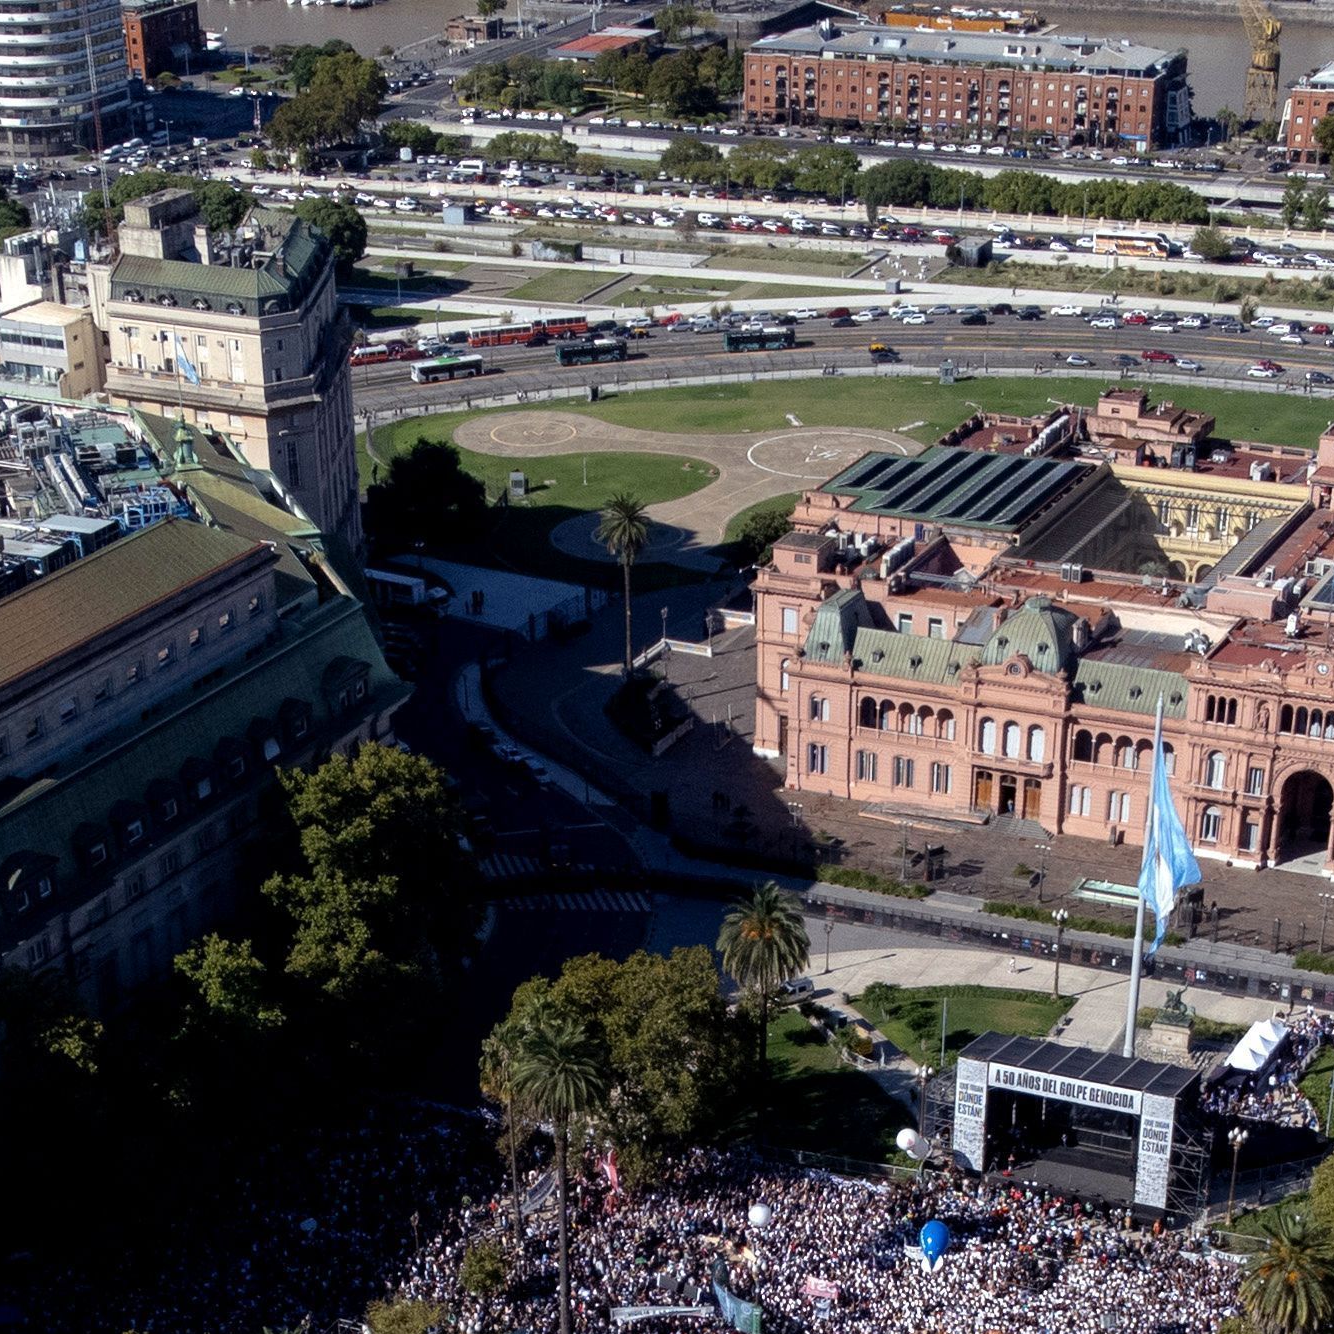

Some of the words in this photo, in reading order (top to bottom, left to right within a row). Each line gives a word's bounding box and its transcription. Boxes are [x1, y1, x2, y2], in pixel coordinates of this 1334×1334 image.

[995, 1069, 1001, 1083] A
[1003, 1070, 1015, 1086] 50
[1017, 1072, 1041, 1091] AÑOS
[1042, 1077, 1057, 1095] DEL
[1059, 1082, 1088, 1100] GOLPE
[1089, 1087, 1134, 1109] GENOCIDA
